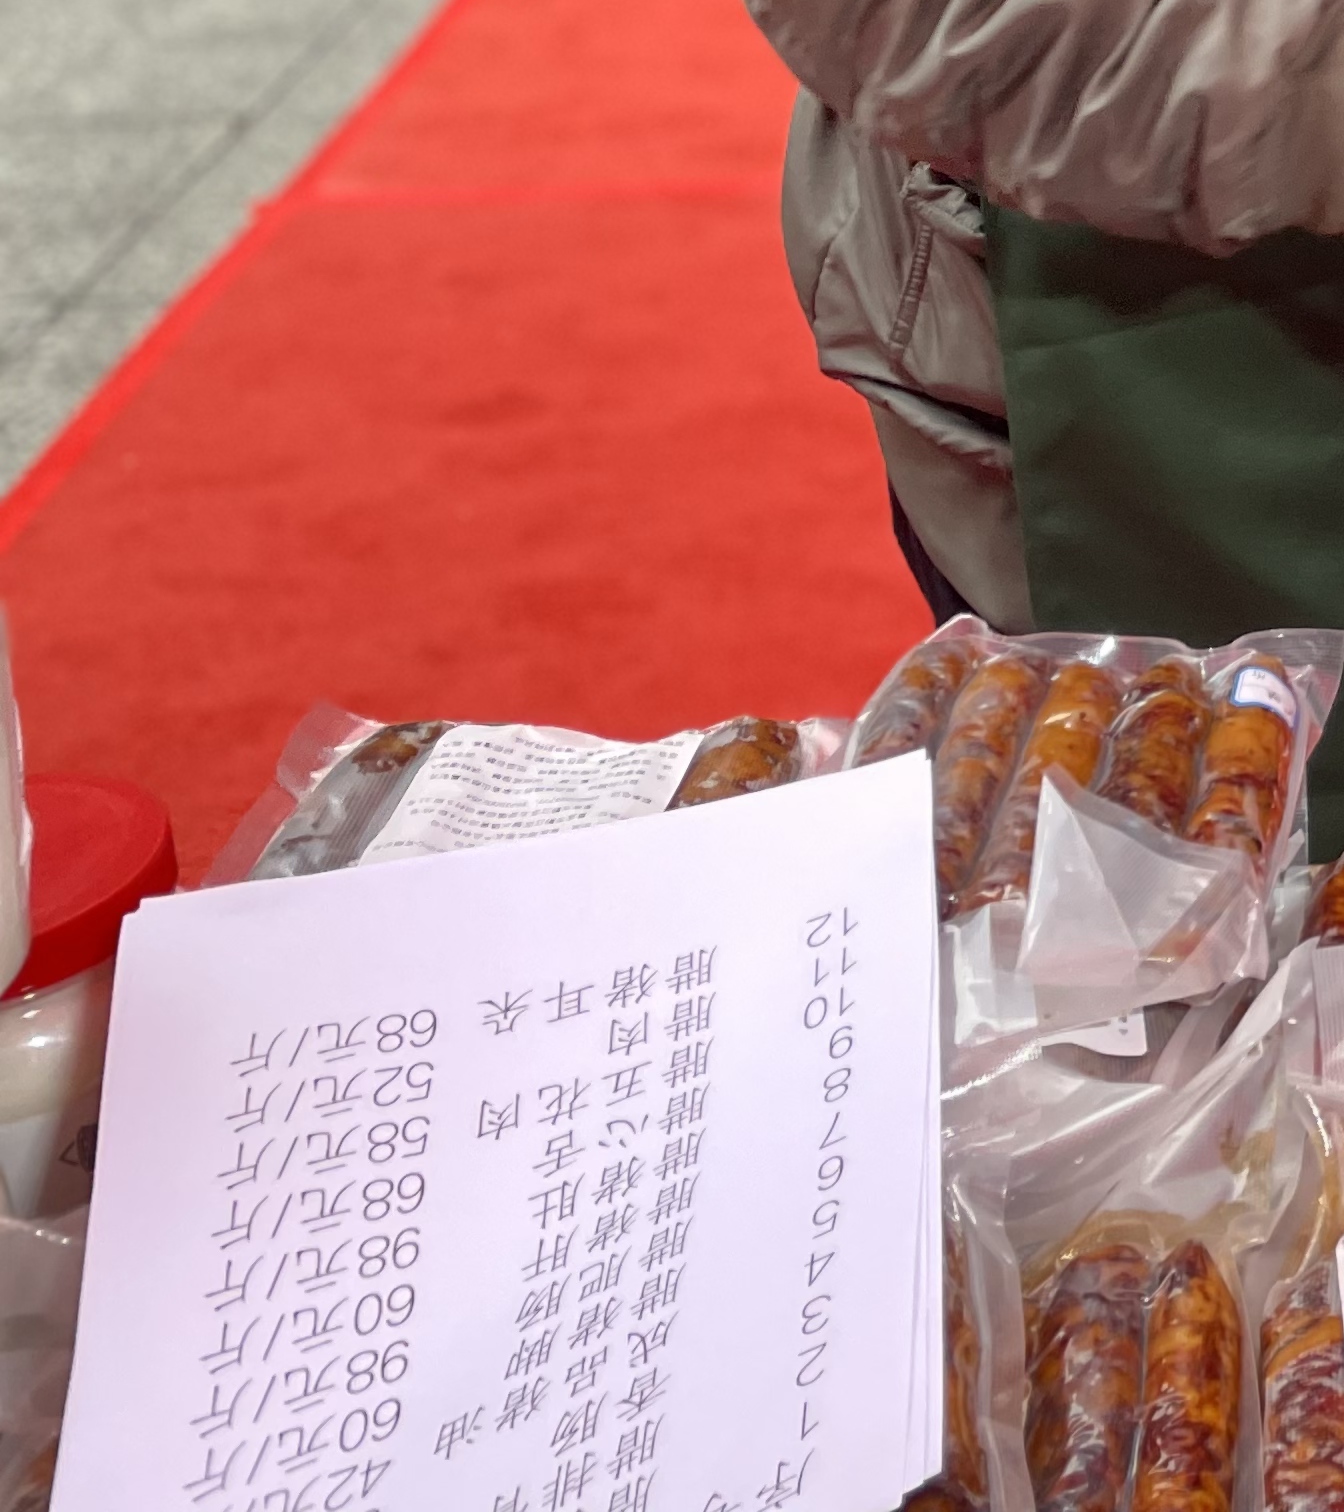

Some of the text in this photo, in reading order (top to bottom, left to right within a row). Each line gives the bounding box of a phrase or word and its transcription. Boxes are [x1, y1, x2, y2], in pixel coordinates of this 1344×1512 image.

[224, 946, 857, 1134] 11 腊肉 52元/斤
[229, 906, 859, 1078] 12 腊猪耳朵 68元/斤
[210, 1025, 854, 1251] 9 腊心舌 68元/斤
[216, 986, 855, 1191] 10 腊五花肉 58元/斤
[199, 1111, 847, 1376] 7 腊猪肝 60元/斤
[204, 1067, 852, 1313] 8 腊猪肚 98元/斤
[803, 1251, 836, 1288] 4
[182, 1199, 841, 1503] 5 腊猪脚 60元/斤
[189, 1155, 845, 1440] 6 腊肥肠 98元/斤
[433, 1310, 679, 1461] 成品猪油
[549, 1294, 832, 1458] 3 香肠
[795, 1341, 828, 1387] 2
[800, 1401, 820, 1441] 1
